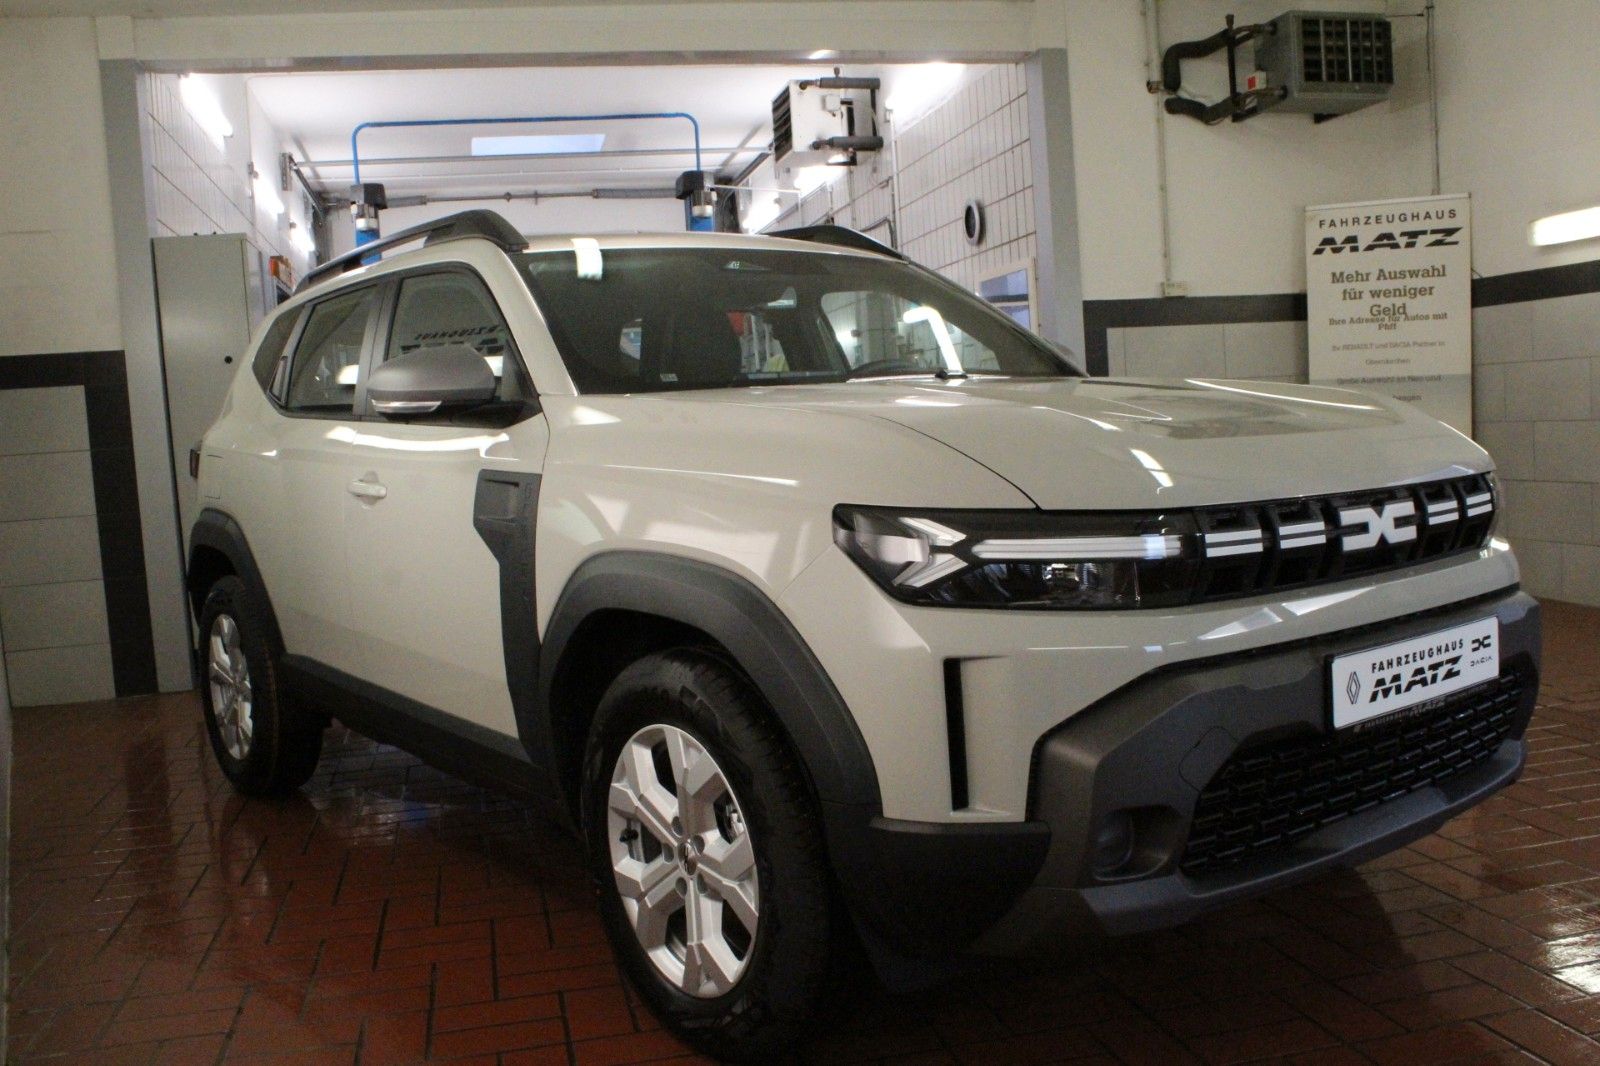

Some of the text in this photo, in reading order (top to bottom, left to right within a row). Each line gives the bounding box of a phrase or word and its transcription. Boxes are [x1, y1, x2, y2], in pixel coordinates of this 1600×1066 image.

[1319, 209, 1457, 228] FAHRZEUGHAUS
[1312, 226, 1463, 255] MATZ
[1331, 264, 1447, 284] Mehr Auswahl
[1342, 285, 1435, 301] für weniger
[1349, 315, 1385, 325] Adresse
[1403, 313, 1430, 322] Autos
[1370, 303, 1407, 317] Geld
[1371, 638, 1464, 674] FAHRZEUGHAUS
[1369, 654, 1463, 704] MATZ
